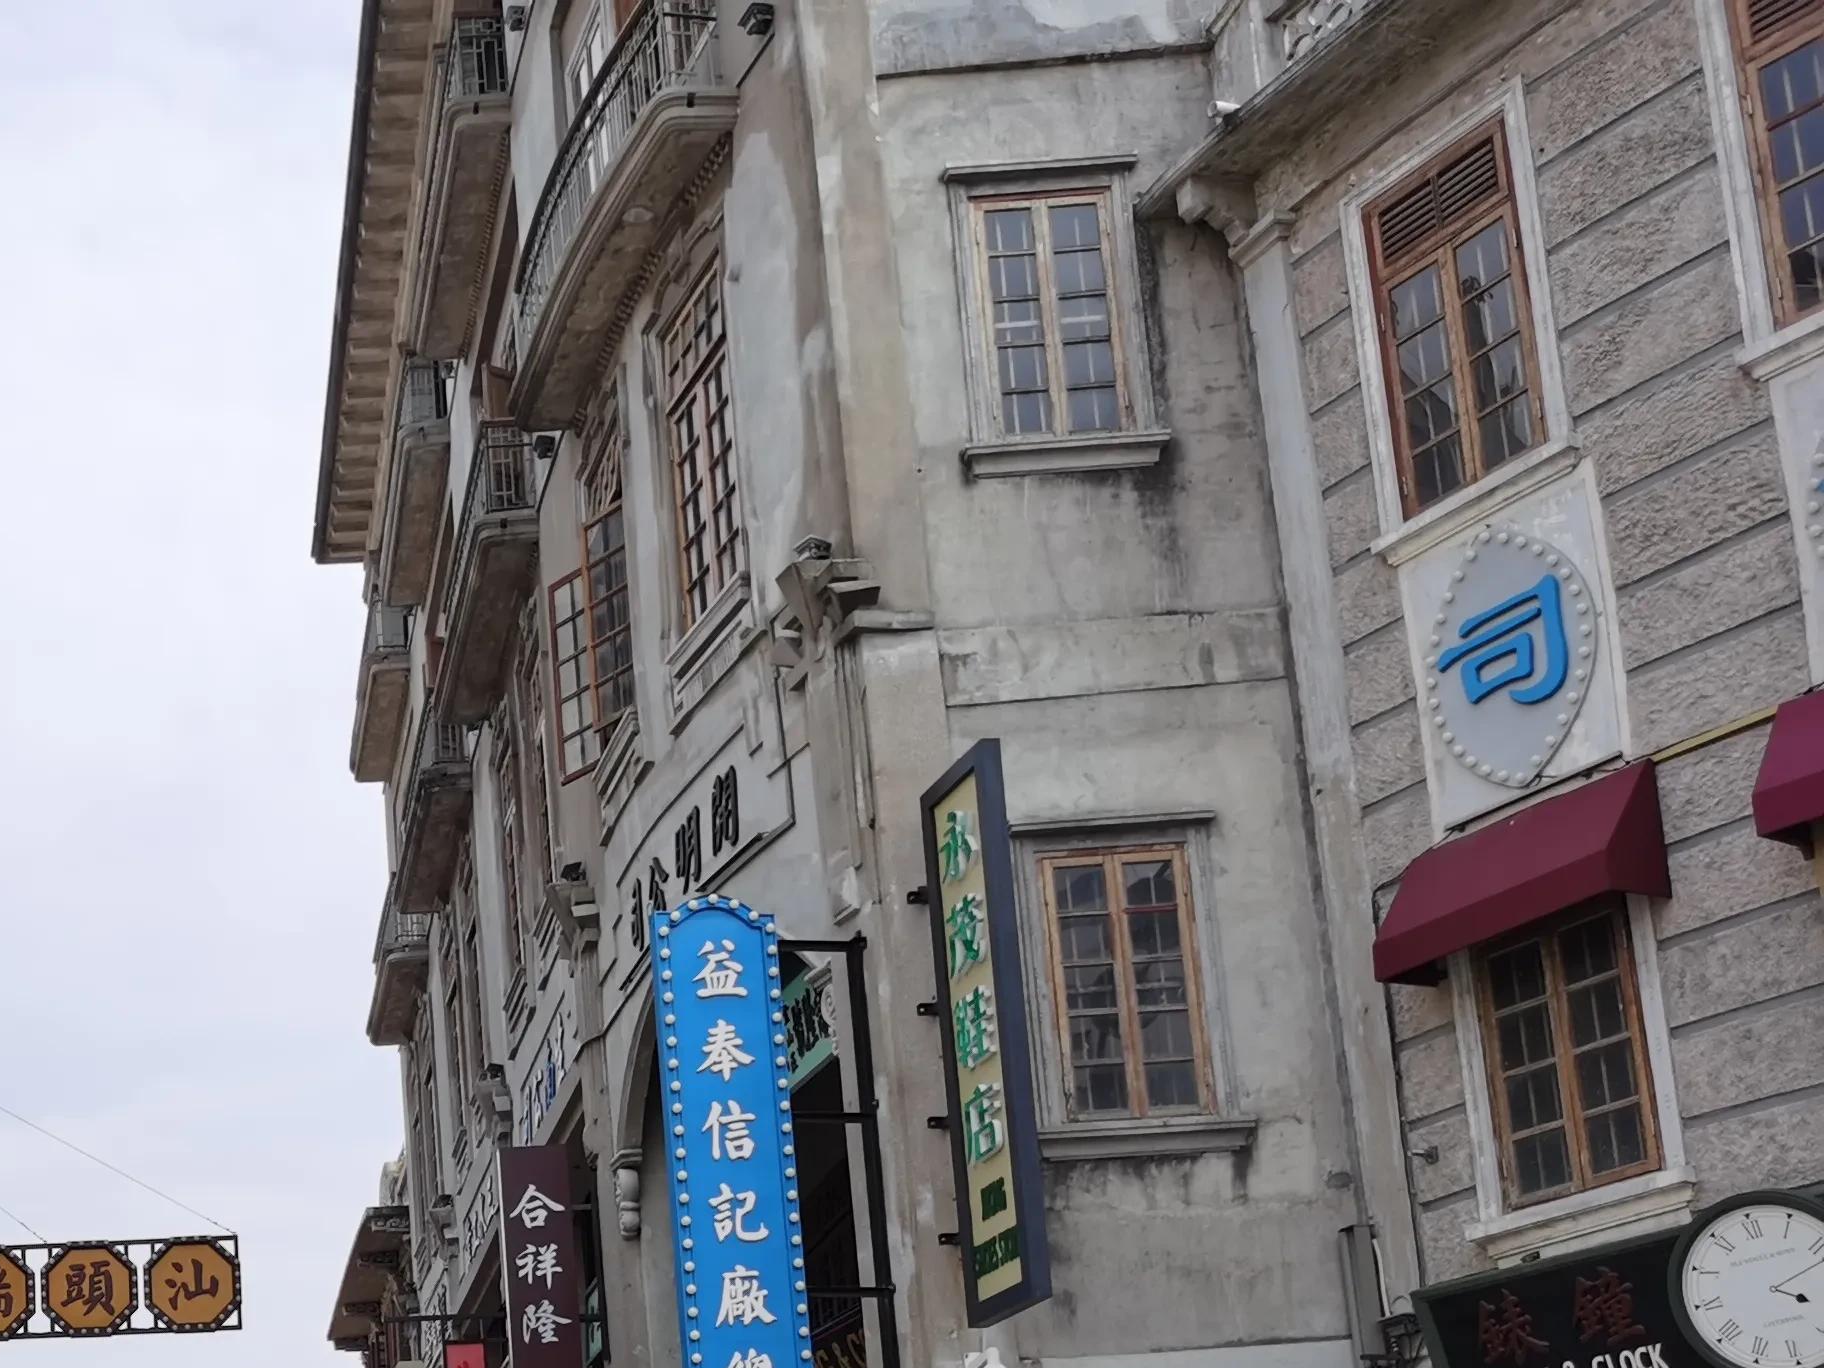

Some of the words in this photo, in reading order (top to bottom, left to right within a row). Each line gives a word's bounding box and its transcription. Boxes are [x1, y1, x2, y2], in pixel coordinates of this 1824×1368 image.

[1435, 573, 1569, 704] 司
[508, 1183, 573, 1345] 合祥隆
